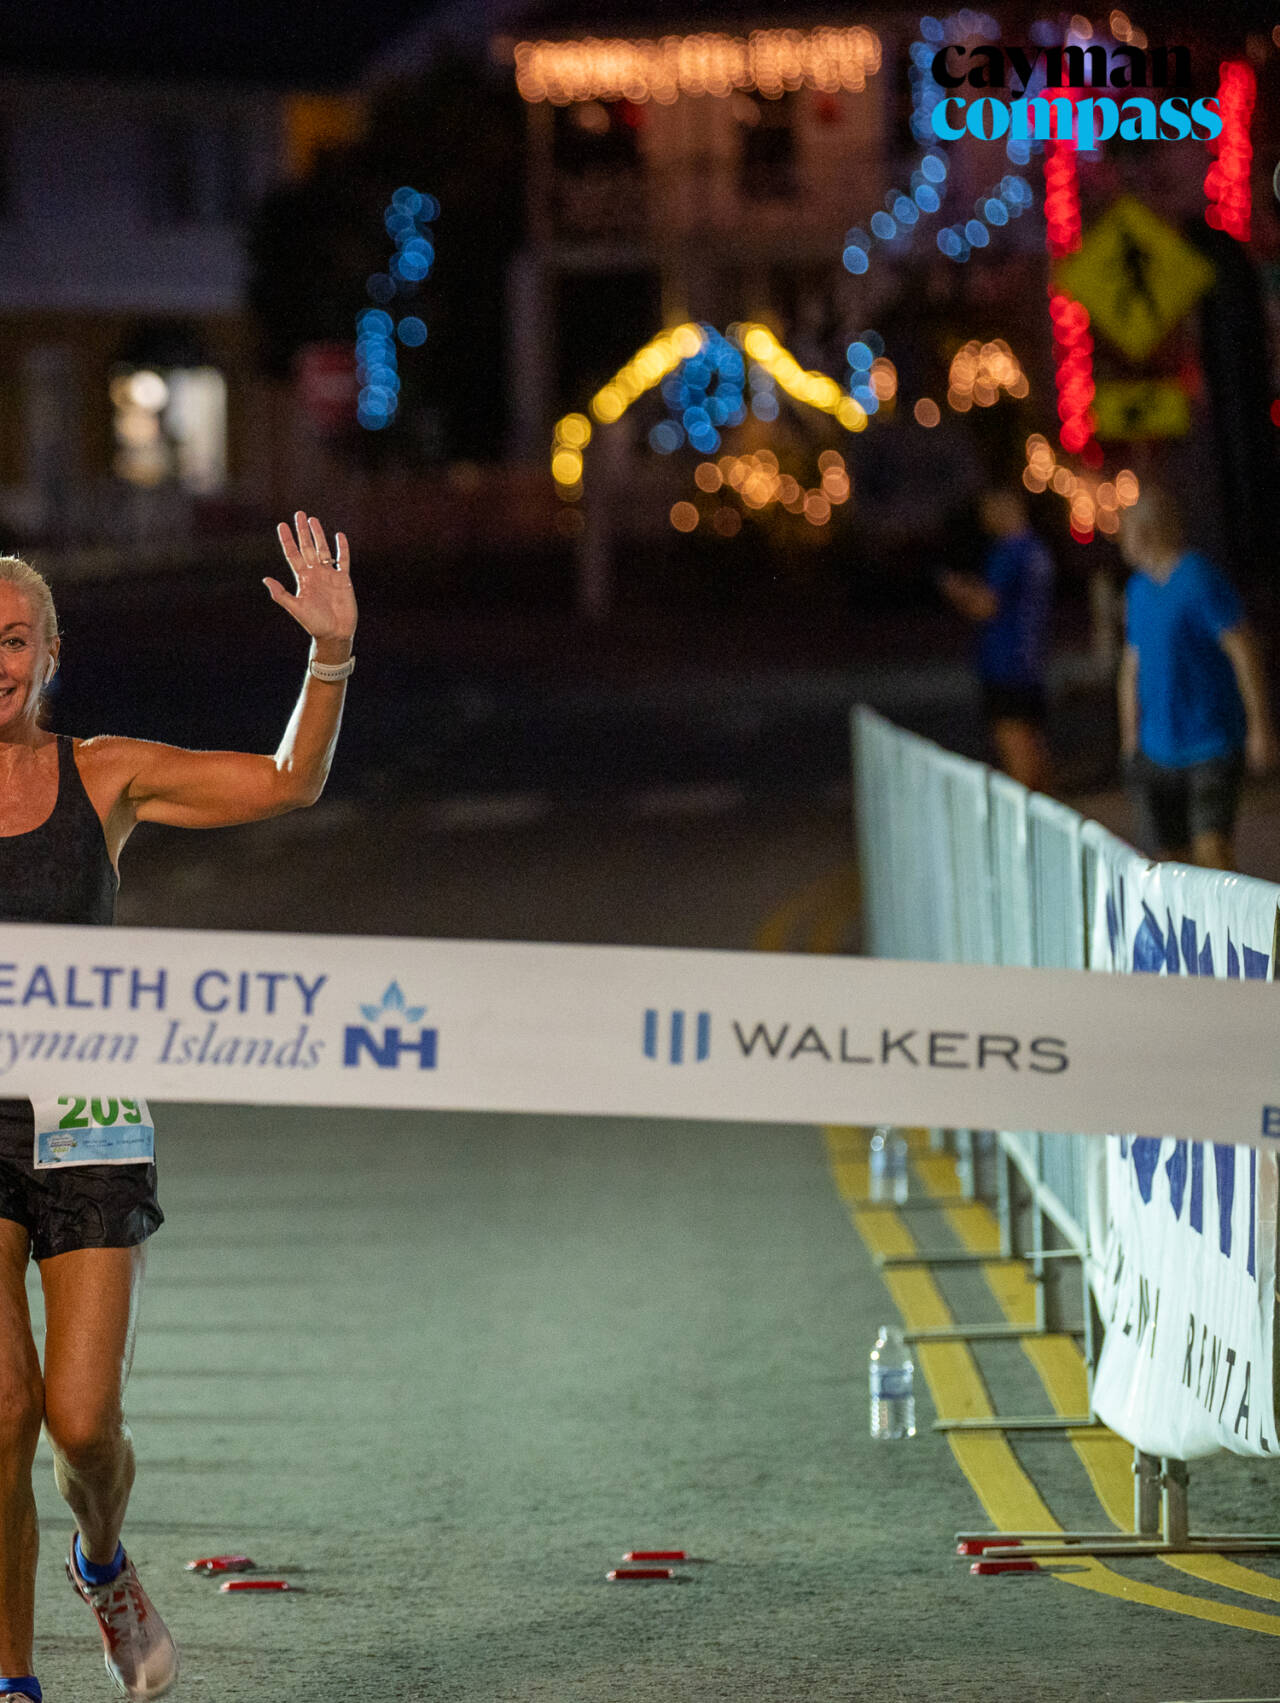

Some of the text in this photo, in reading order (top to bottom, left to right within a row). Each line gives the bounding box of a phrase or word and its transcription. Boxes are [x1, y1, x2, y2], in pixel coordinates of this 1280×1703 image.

[192, 969, 329, 1017] CITY
[156, 1017, 326, 1070] Islands
[342, 1025, 440, 1071] NH
[733, 1020, 1071, 1075] WALKERS
